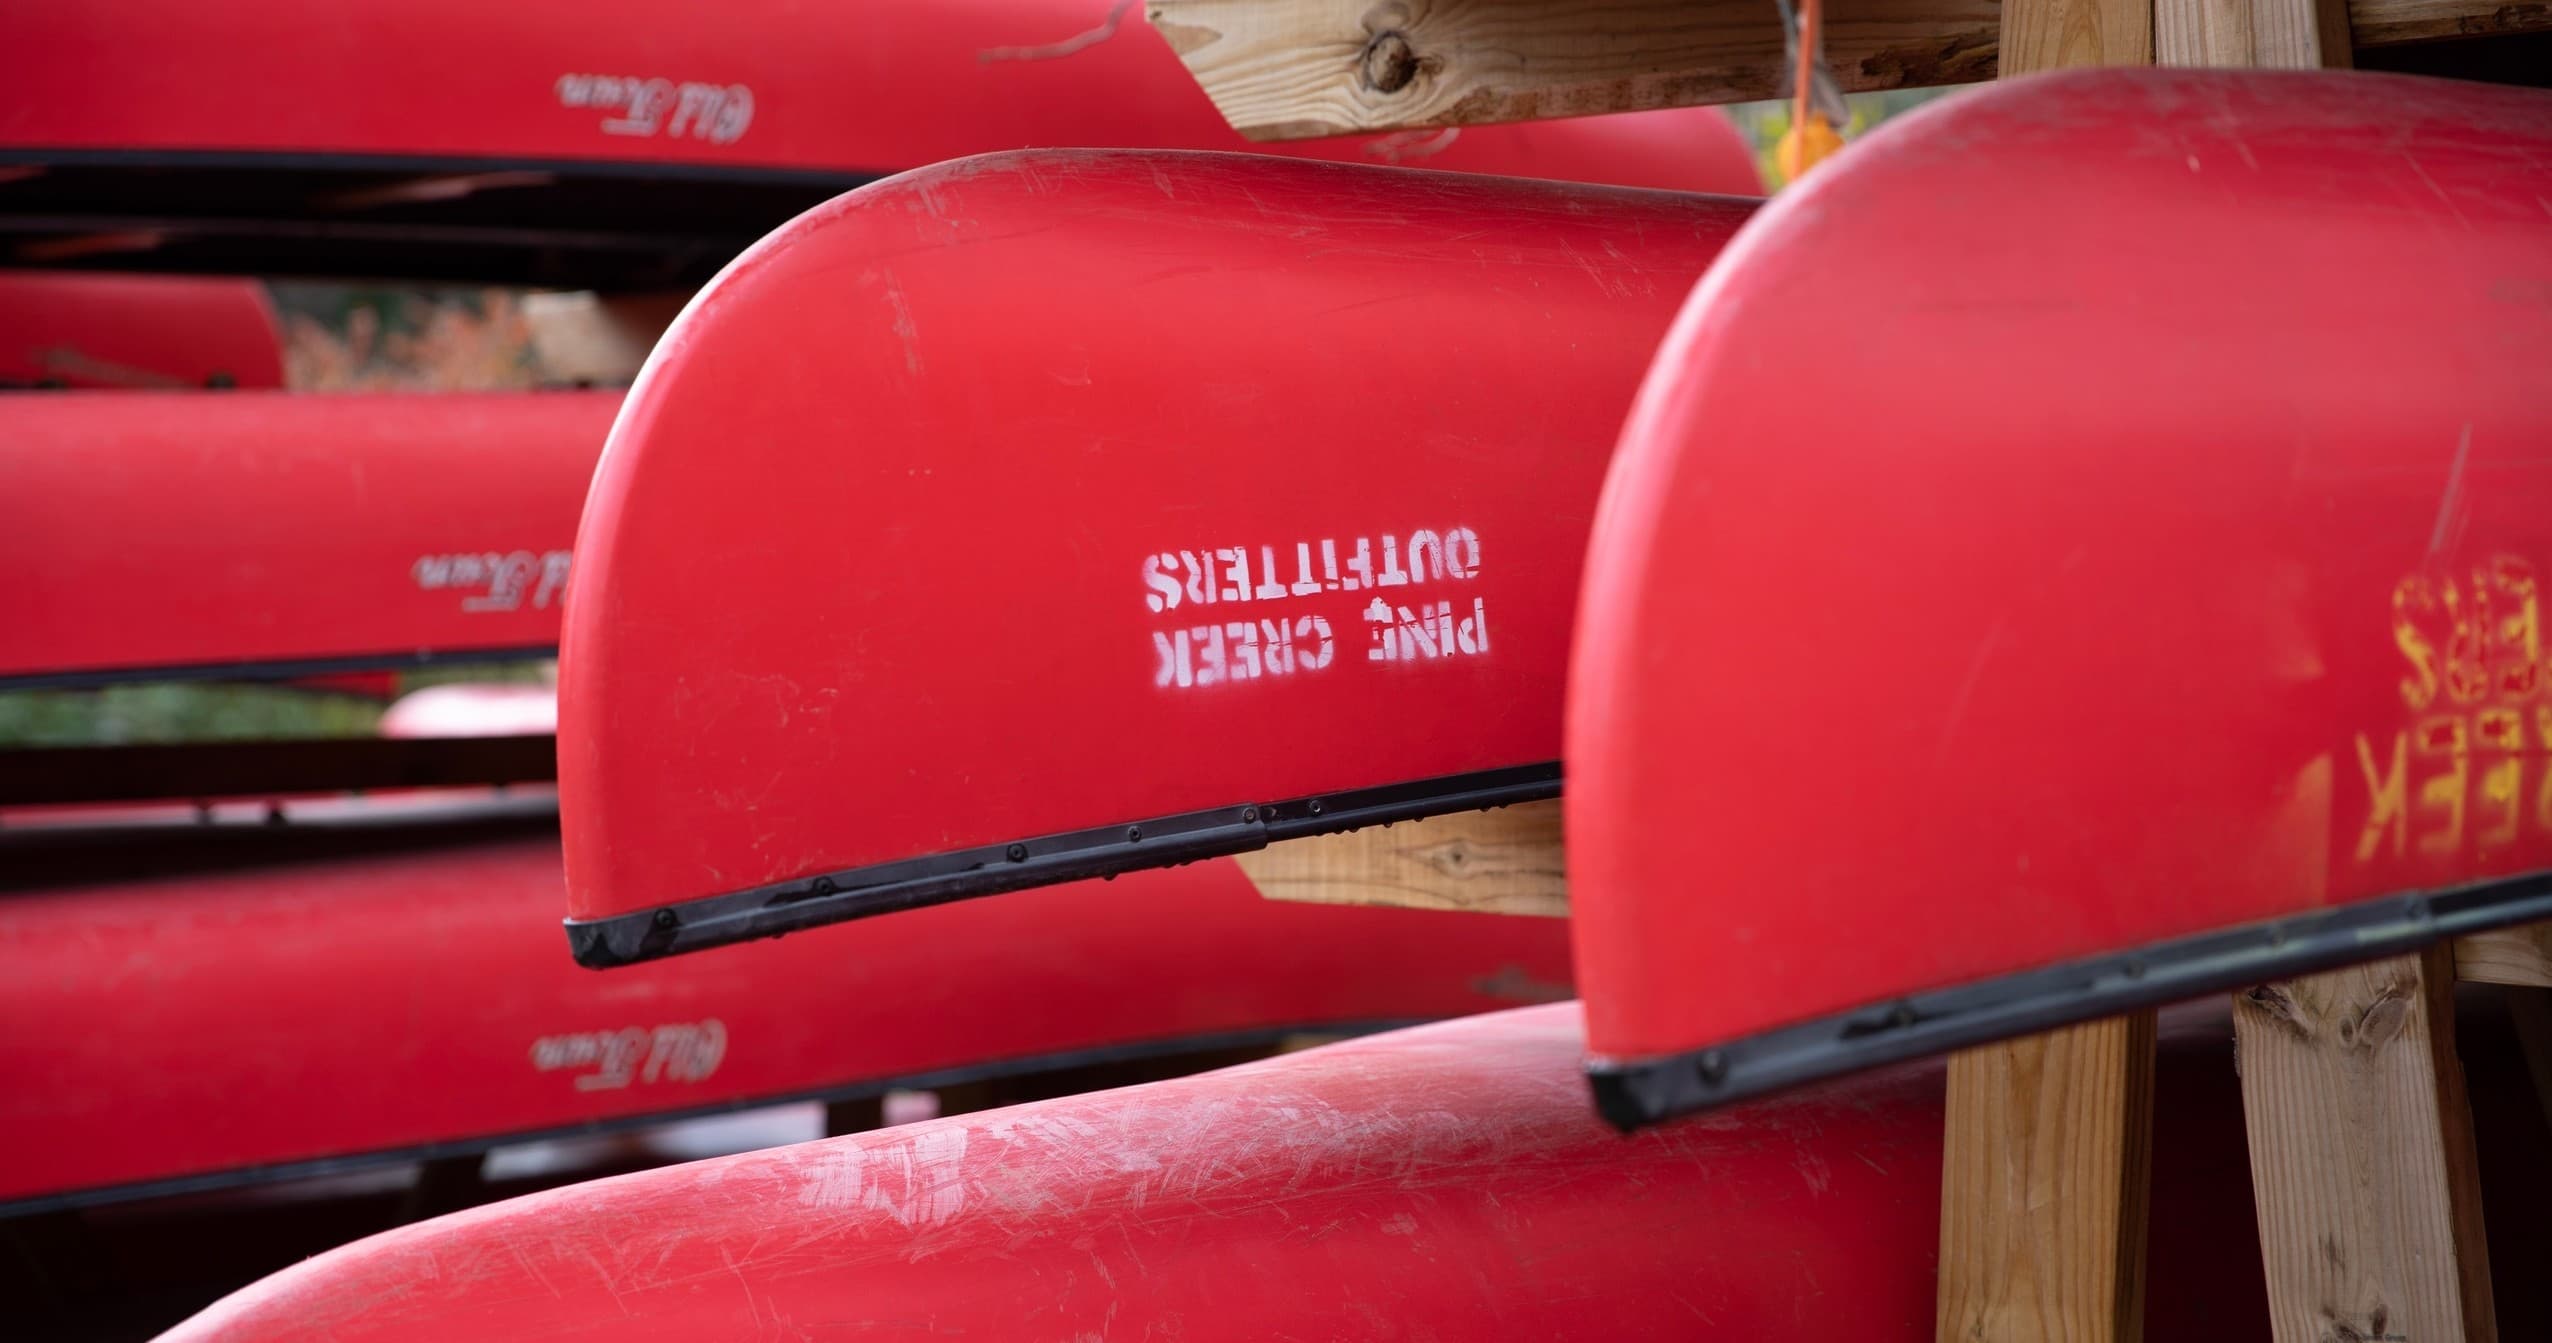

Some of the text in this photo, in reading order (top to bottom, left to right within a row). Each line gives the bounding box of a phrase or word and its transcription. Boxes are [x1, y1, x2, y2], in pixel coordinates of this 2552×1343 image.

[554, 73, 755, 144] Old Town
[411, 549, 539, 613] Town
[1142, 526, 1482, 614] OUTFITTERS
[1151, 596, 1489, 689] PINE CREEK
[2392, 552, 2552, 711] ERS
[529, 1017, 728, 1092] Old Town
